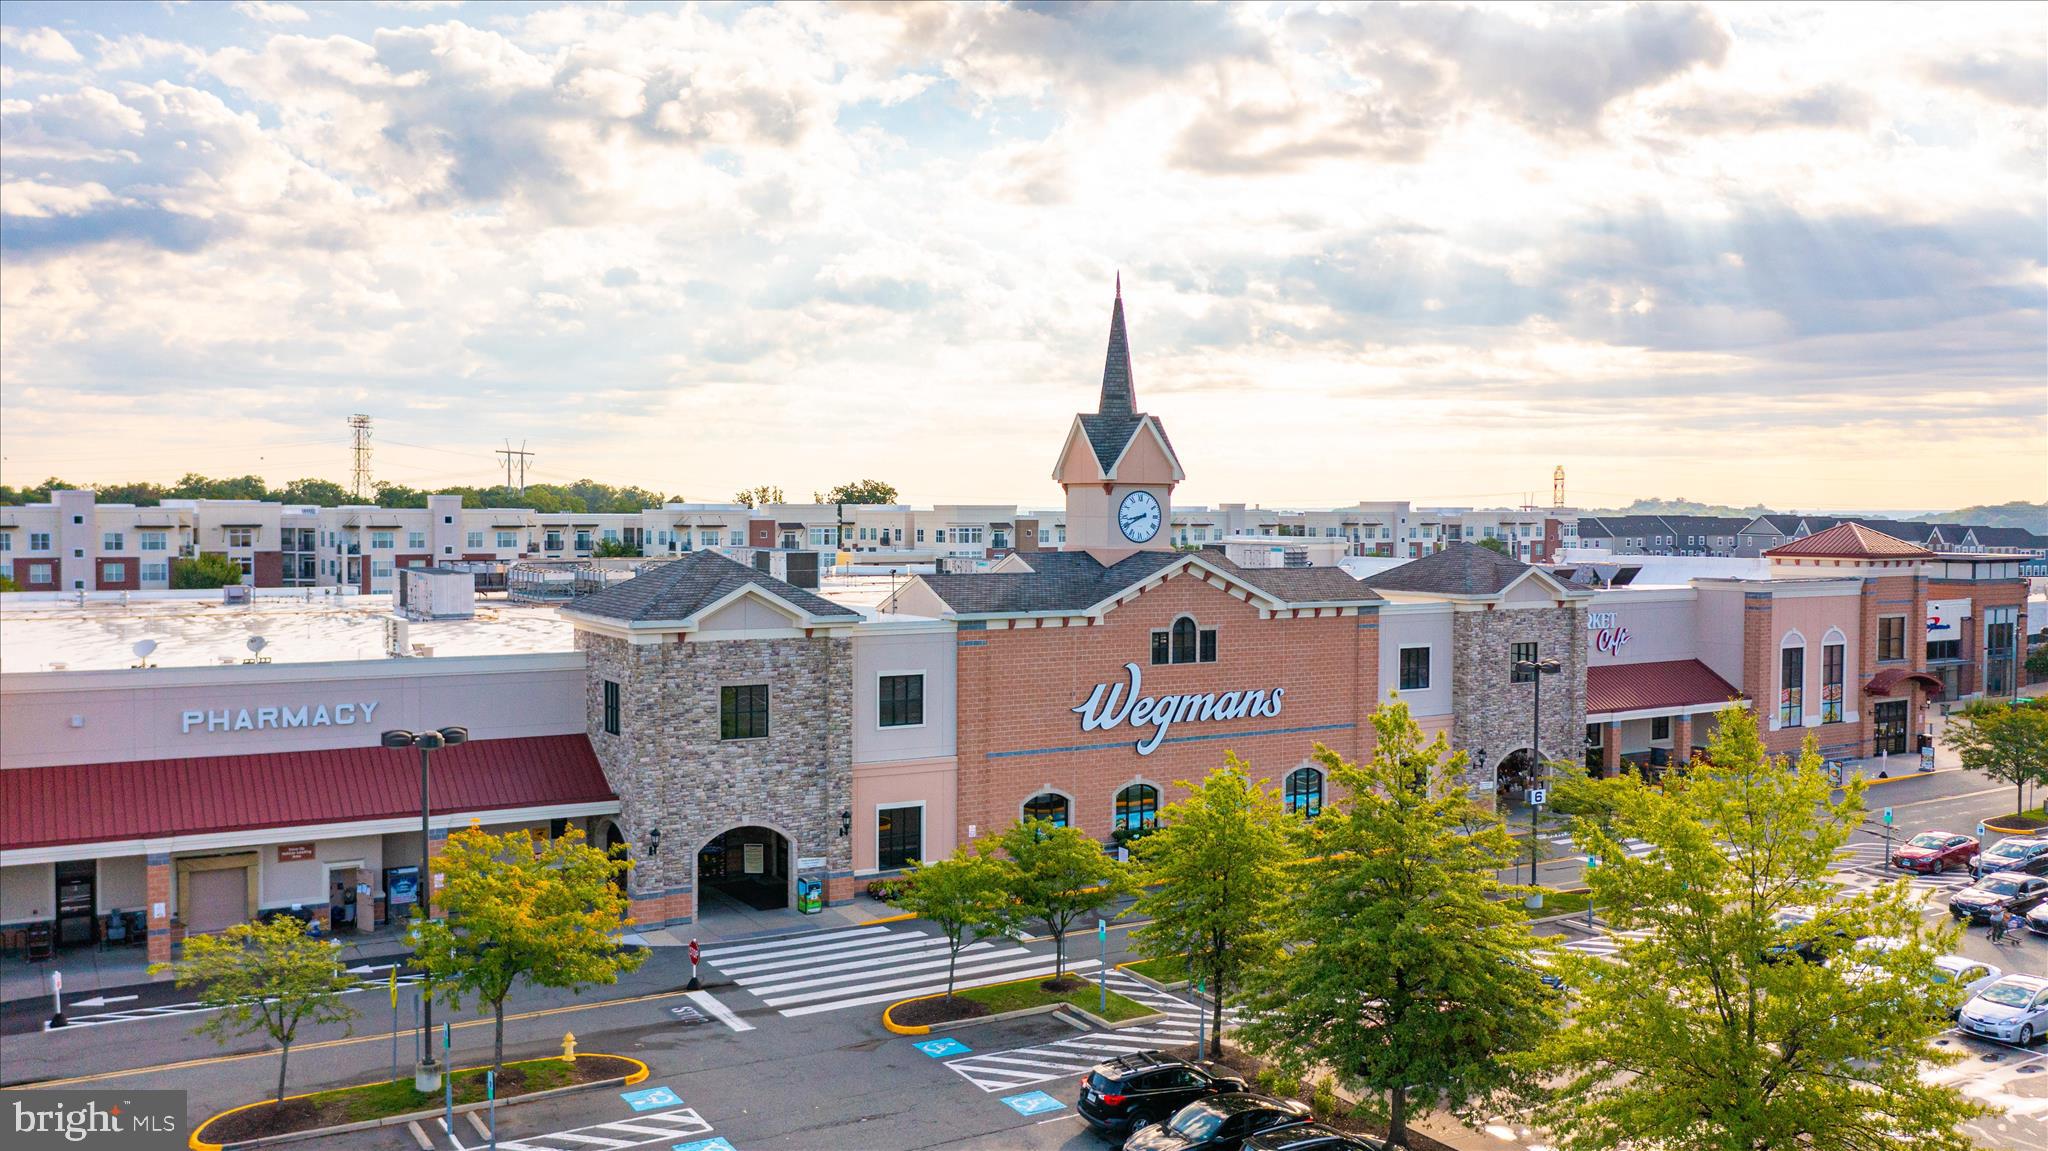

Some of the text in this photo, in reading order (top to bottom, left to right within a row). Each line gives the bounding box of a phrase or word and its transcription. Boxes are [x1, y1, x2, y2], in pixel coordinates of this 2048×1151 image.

[182, 701, 379, 733] PHARMACY
[1071, 662, 1284, 756] Wegmans
[1535, 791, 1542, 802] 6
